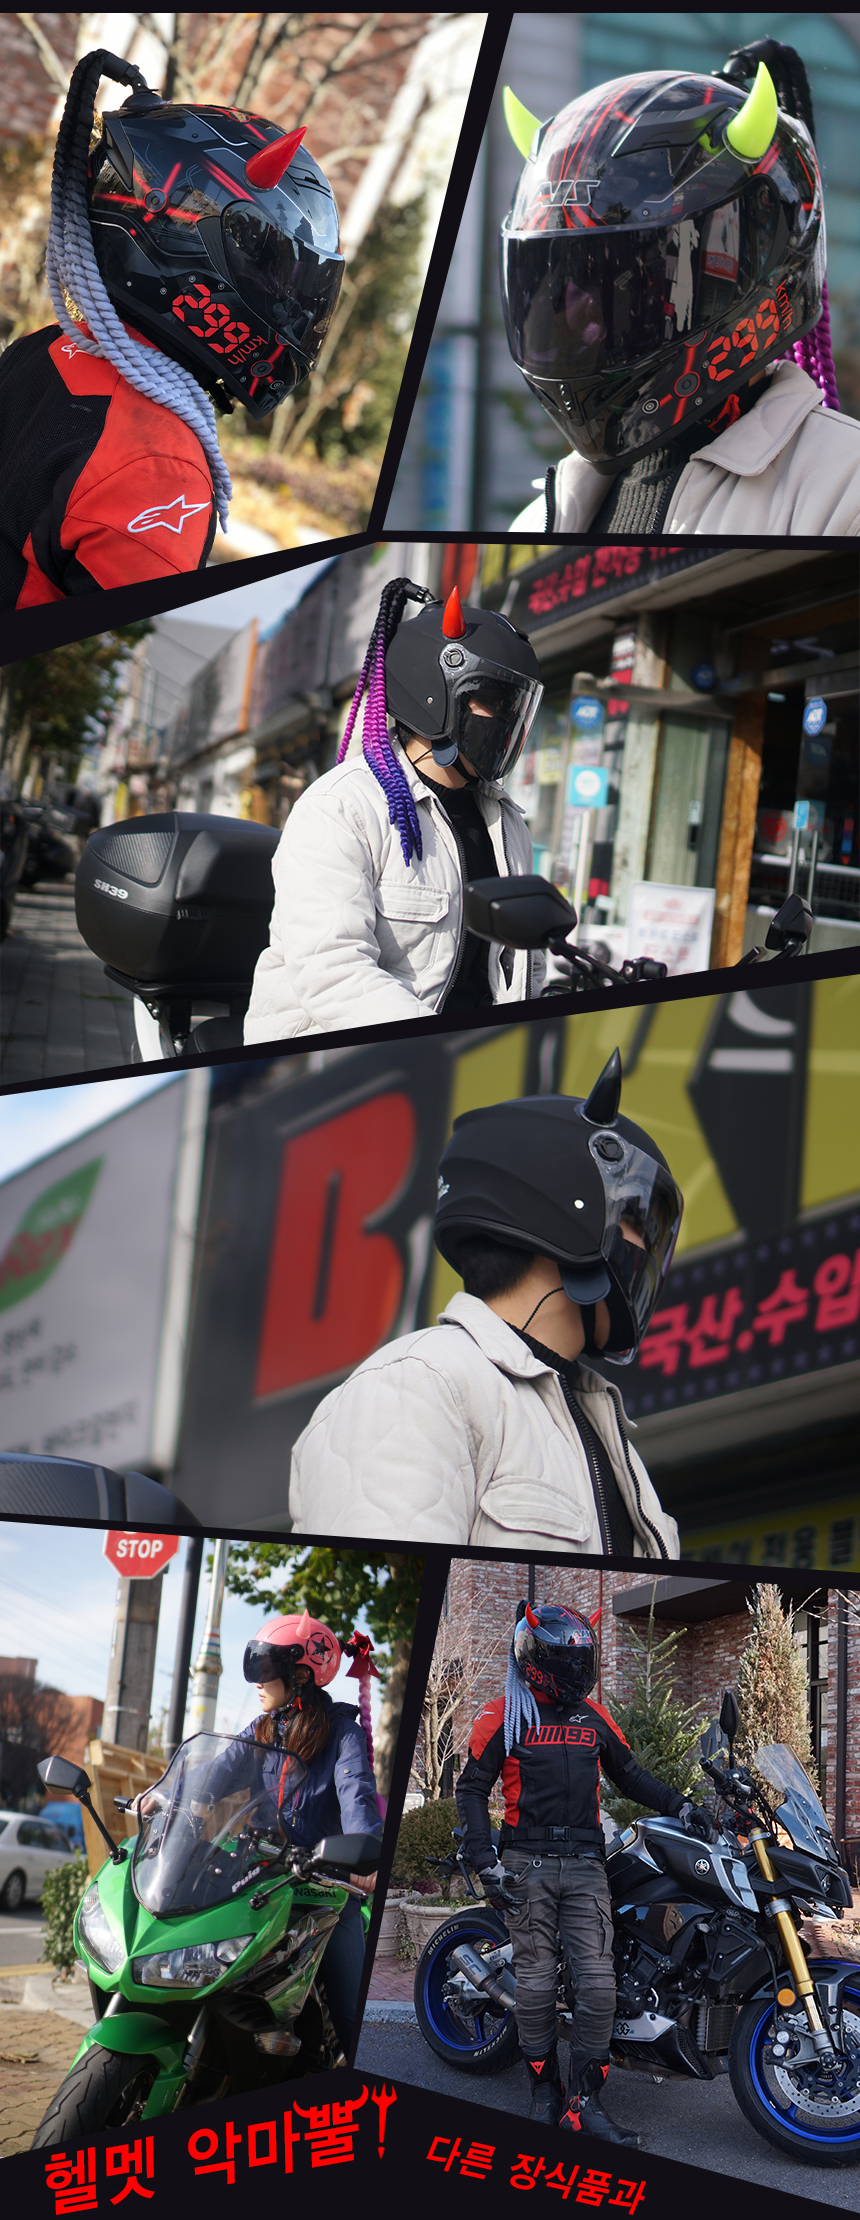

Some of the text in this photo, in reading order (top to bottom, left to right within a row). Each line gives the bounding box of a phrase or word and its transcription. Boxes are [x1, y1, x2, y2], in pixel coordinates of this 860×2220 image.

[172, 283, 269, 365] 299 km/h
[706, 279, 794, 382] 299 km/h
[93, 878, 129, 900] SH39
[116, 1538, 164, 1559] STOP
[525, 1662, 544, 1685] 299
